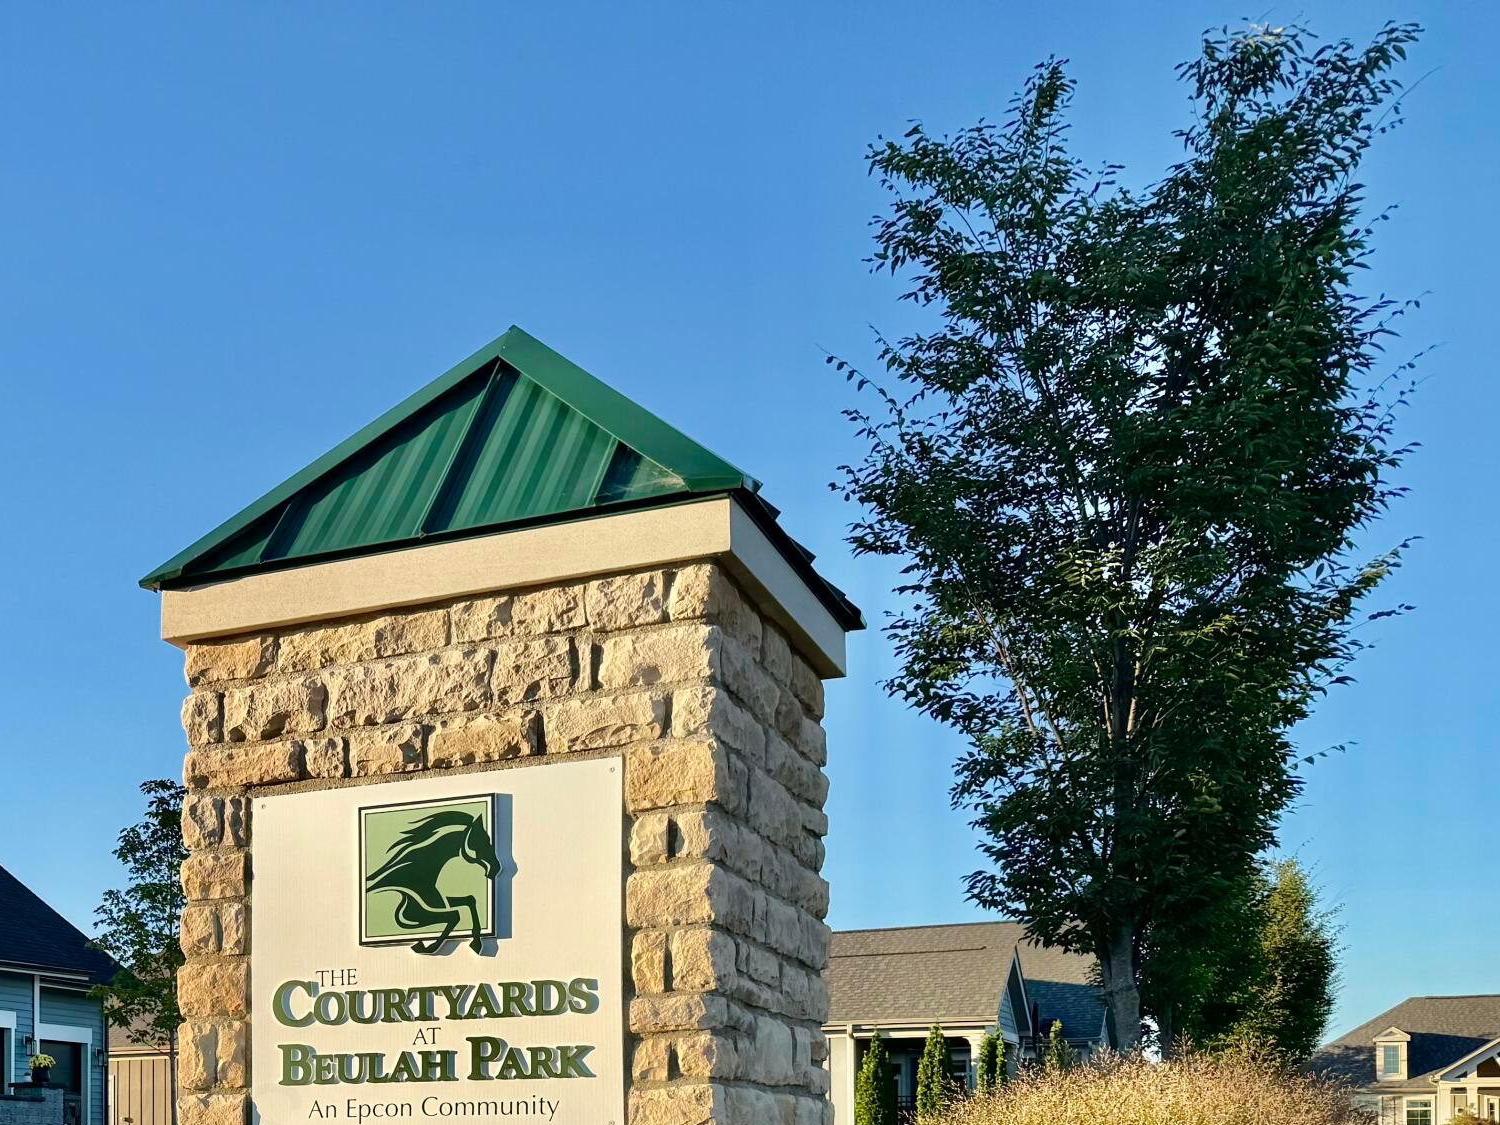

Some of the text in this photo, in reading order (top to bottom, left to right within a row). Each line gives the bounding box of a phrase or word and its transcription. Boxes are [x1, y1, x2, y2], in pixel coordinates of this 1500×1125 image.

[315, 968, 358, 987] THE
[272, 978, 600, 1028] COURTYARDS
[413, 1027, 441, 1045] AT
[277, 1035, 597, 1086] BEULAH PARK
[308, 1095, 561, 1124] An Epcon Community
